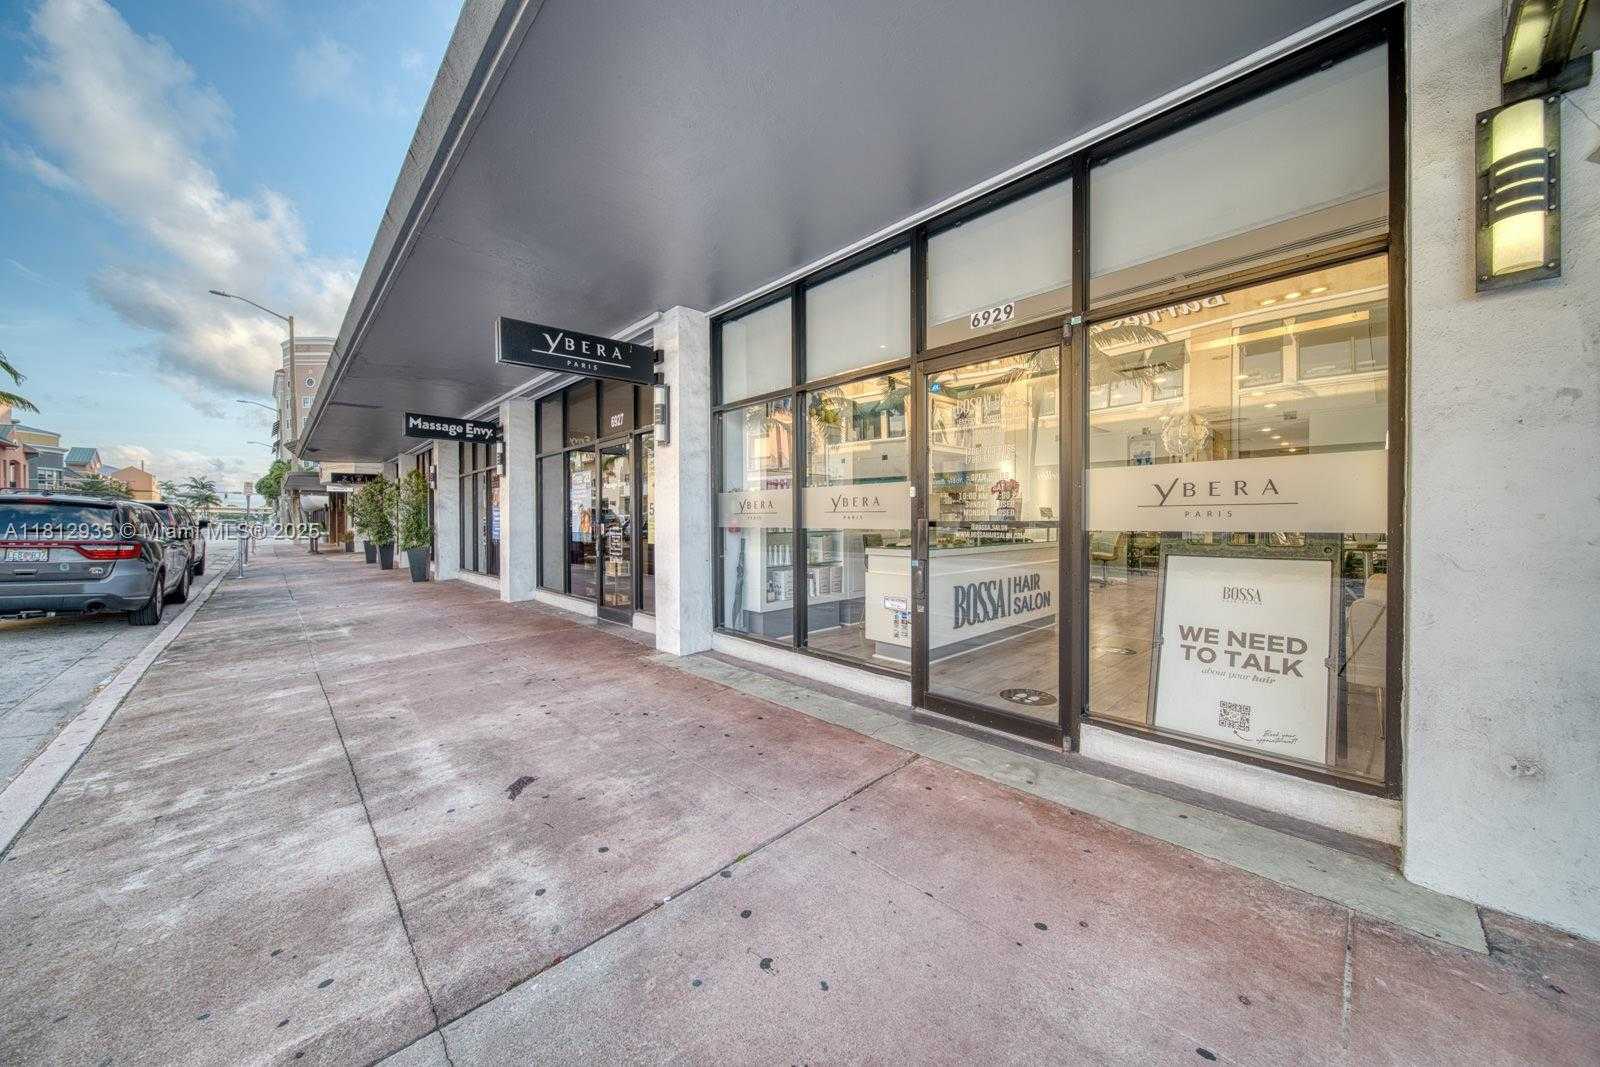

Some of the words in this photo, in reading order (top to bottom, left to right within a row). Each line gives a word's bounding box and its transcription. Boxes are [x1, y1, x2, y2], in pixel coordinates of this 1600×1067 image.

[971, 303, 1014, 328] 6929
[542, 332, 622, 360] YBERA
[567, 360, 598, 371] PARIS
[409, 416, 463, 436] Massage
[610, 412, 624, 428] 6927
[1154, 478, 1279, 506] YBERA
[738, 498, 774, 513] YBERA
[831, 494, 880, 512] YBERA
[1184, 510, 1233, 518] PARIS
[1013, 573, 1041, 594] HAIR
[953, 578, 1007, 630] BOSSA
[1013, 591, 1051, 615] SALON
[1223, 586, 1262, 602] BOSSA
[1178, 624, 1220, 645] WE
[1227, 630, 1308, 655] NEED
[1180, 643, 1217, 664] TO
[1224, 650, 1304, 678] TALK
[1201, 666, 1226, 677] about
[1252, 674, 1276, 684] hair
